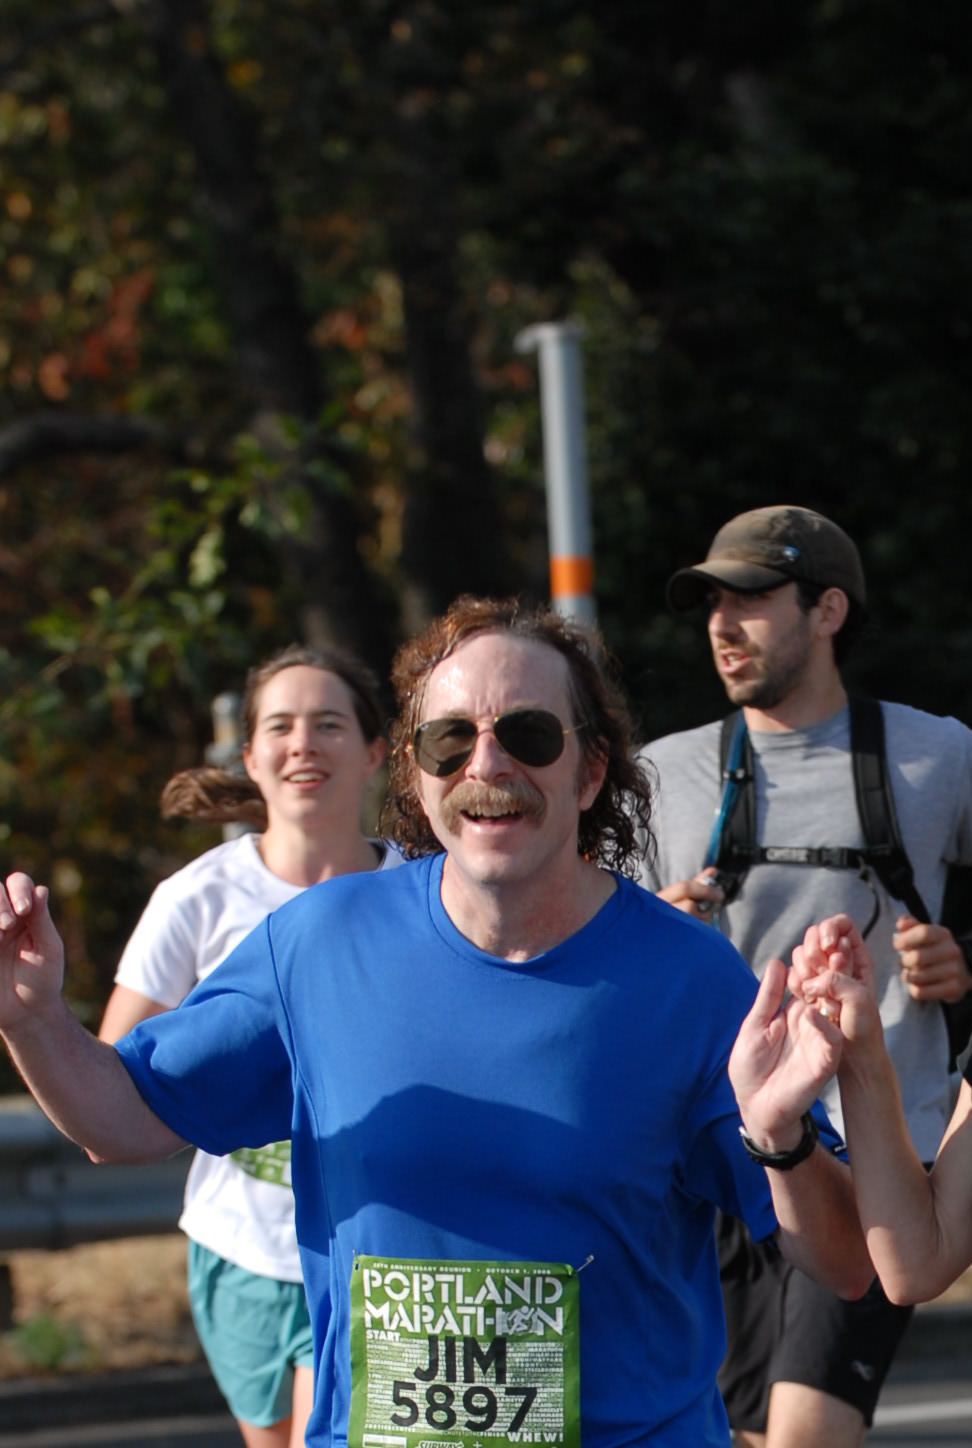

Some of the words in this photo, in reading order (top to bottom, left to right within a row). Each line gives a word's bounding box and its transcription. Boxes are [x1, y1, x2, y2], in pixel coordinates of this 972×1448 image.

[362, 1268, 563, 1305] PORTLAND
[366, 1329, 400, 1341] START
[413, 1335, 507, 1385] JIM
[390, 1380, 538, 1432] 5897
[507, 1431, 564, 1442] WHEW!
